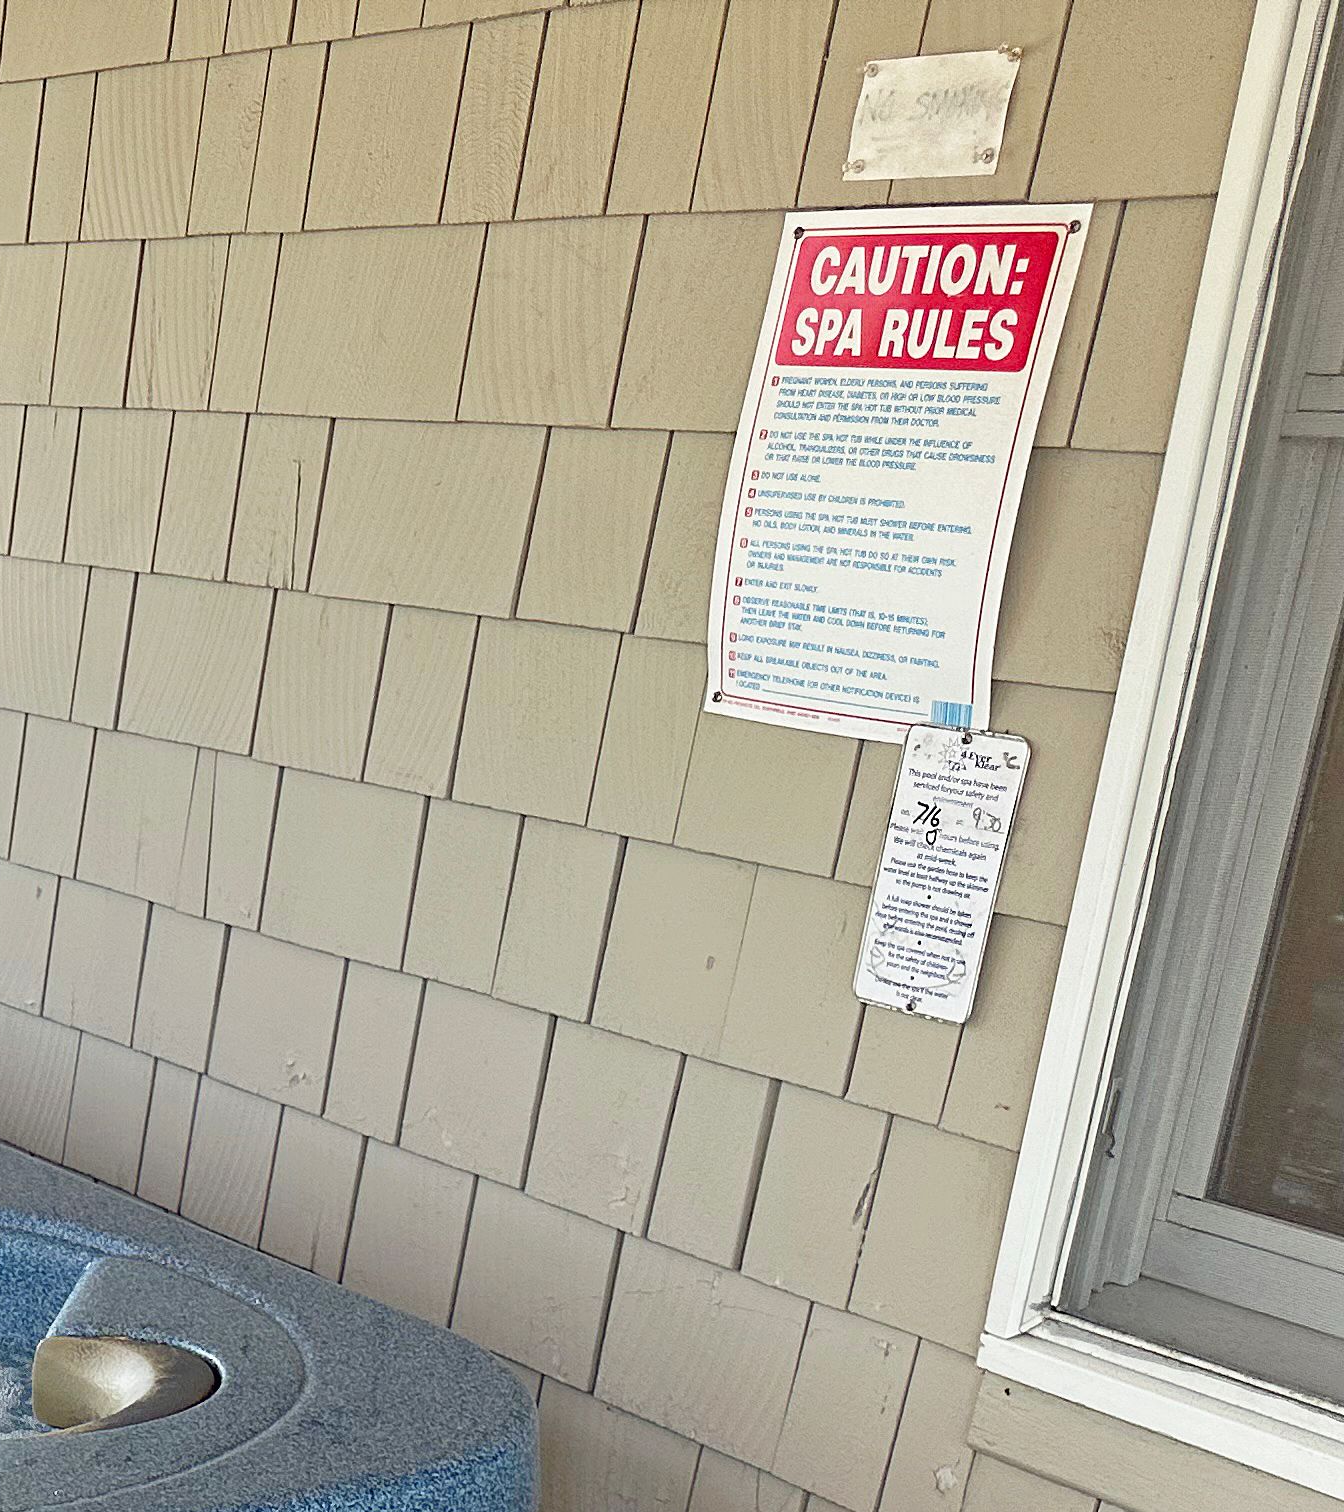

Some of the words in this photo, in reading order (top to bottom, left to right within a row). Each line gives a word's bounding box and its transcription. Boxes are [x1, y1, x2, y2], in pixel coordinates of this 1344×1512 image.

[810, 243, 1029, 297] CAUTION:
[791, 307, 862, 357] SPA
[877, 307, 1018, 361] RULES
